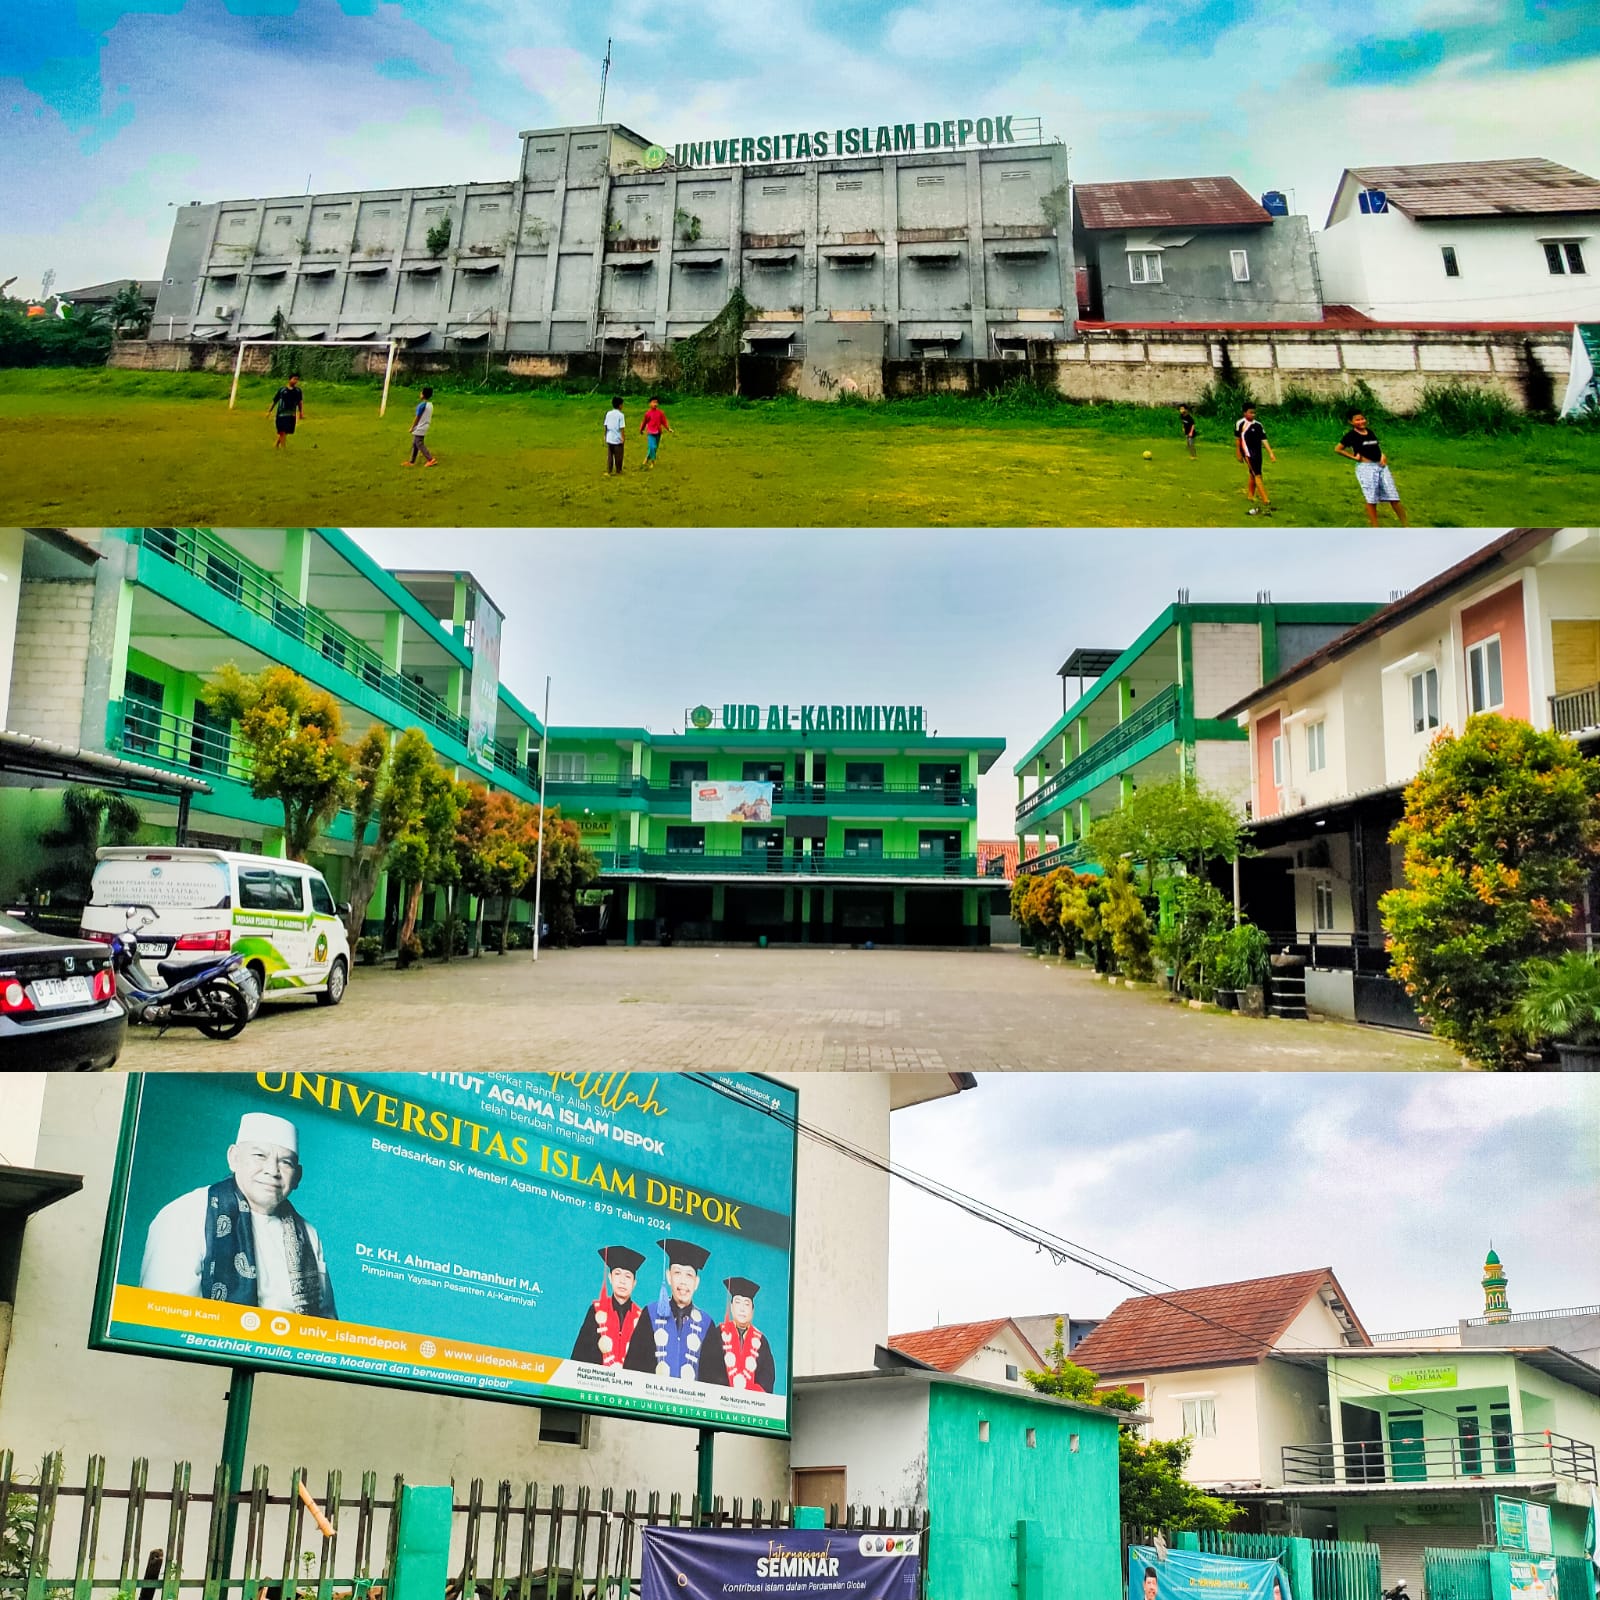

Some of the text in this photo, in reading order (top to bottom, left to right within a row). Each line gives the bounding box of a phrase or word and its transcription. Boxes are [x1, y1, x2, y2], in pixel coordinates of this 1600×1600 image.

[674, 115, 1015, 168] UNIVERSITAS ISLAM DEPOK
[722, 704, 923, 731] UID AL-KARIMIYAH
[480, 1100, 595, 1146] telah berubah menjadi
[487, 1084, 555, 1120] AGAMA
[559, 1107, 609, 1138] ISLAM
[612, 1125, 666, 1157] DEPOK
[525, 1080, 565, 1103] Rahmat
[567, 1096, 593, 1113] Allah
[594, 1106, 617, 1121] SWT
[256, 1072, 742, 1230] UNIVERSITAS ISLAM DEPOK
[371, 1137, 447, 1169] Berdasarkan
[448, 1159, 465, 1174] SK
[467, 1167, 508, 1186] Menteri
[510, 1177, 548, 1198] Agama
[550, 1188, 587, 1209] Nomor
[594, 1201, 614, 1215] 879
[616, 1207, 646, 1225] Tahun
[647, 1216, 672, 1232] 2024
[355, 1243, 545, 1294] Dr. KH. Ahmad Damanhuri M.A.
[361, 1263, 538, 1308] Pimpinan Yayasan Pesantren Al-Karimiyah
[147, 1302, 546, 1373] Kunjungi Kami univ_islamdepok www.uidepok.ac.id
[255, 1345, 294, 1360] mulia,
[296, 1351, 338, 1365] cerdas
[339, 1353, 388, 1372] Moderat
[389, 1363, 411, 1376] dan
[412, 1365, 477, 1386] berwawasan
[580, 1392, 638, 1408] REKTORAT
[640, 1400, 708, 1418] UNIVERSITAS
[710, 1411, 738, 1422] ISLAM
[722, 1582, 763, 1593] Kontribusi
[786, 1581, 808, 1592] dalam
[809, 1580, 846, 1591] Perdamaian
[846, 1579, 867, 1590] Global
[756, 1557, 840, 1578] SEMINAR
